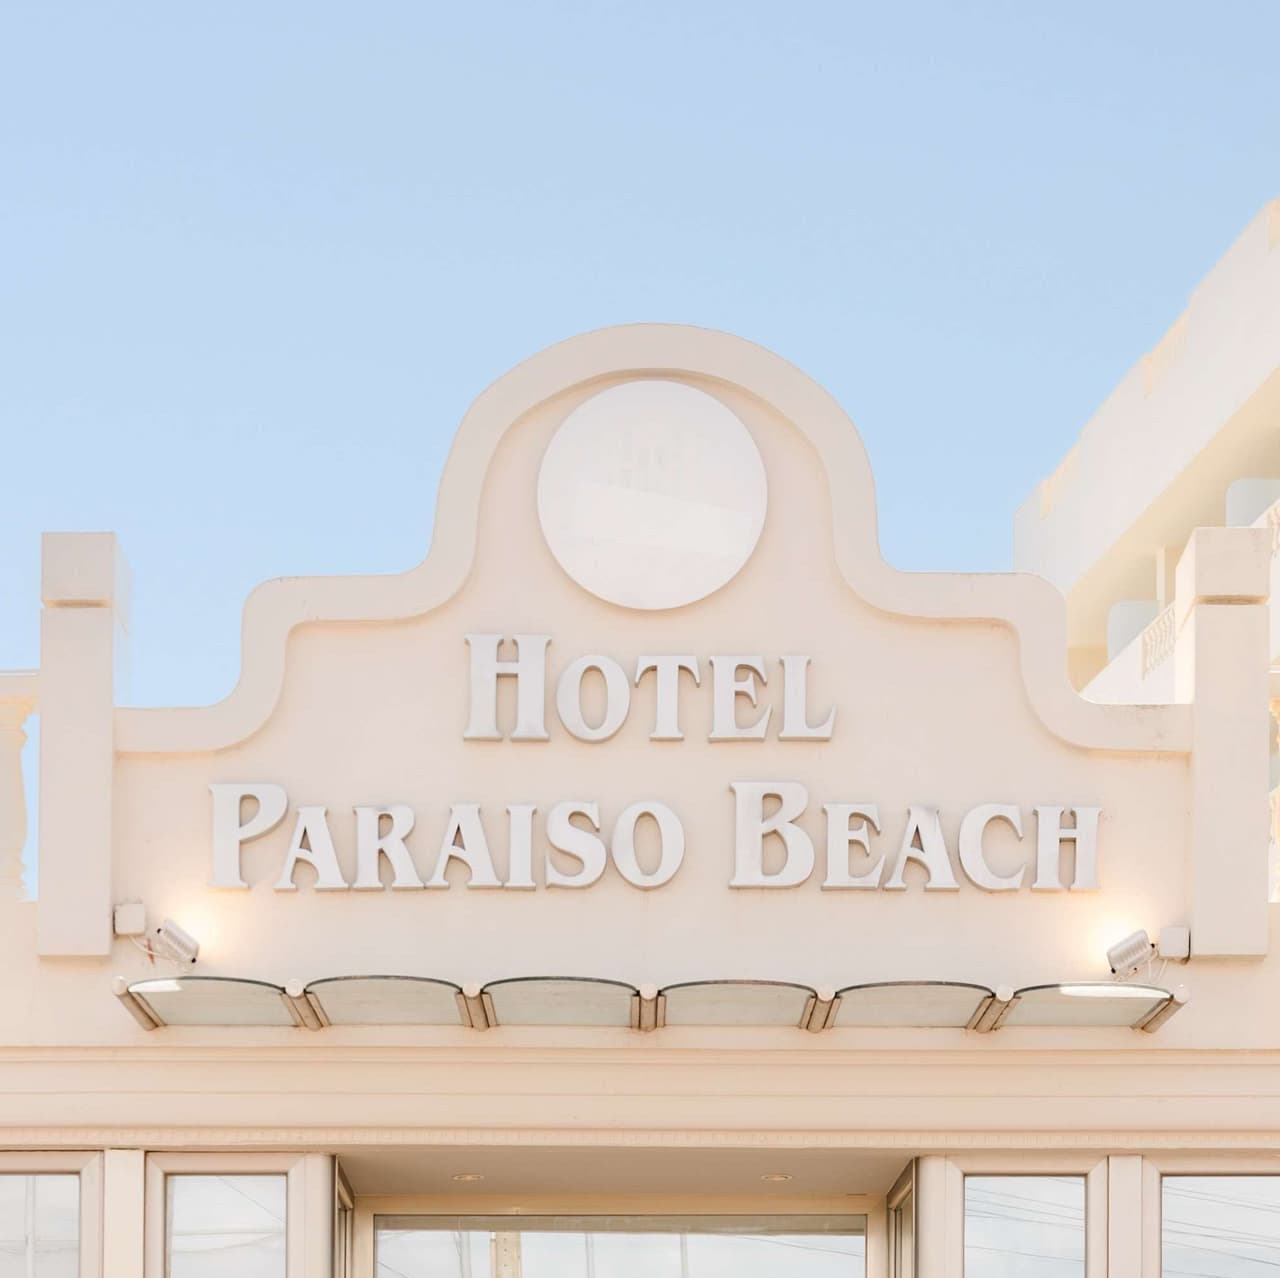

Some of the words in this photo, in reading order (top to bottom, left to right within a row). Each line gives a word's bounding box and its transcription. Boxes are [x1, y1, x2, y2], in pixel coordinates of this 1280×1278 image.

[463, 633, 837, 744] HOTEL
[208, 783, 686, 890] PARAISO
[728, 781, 1103, 892] BEACH
